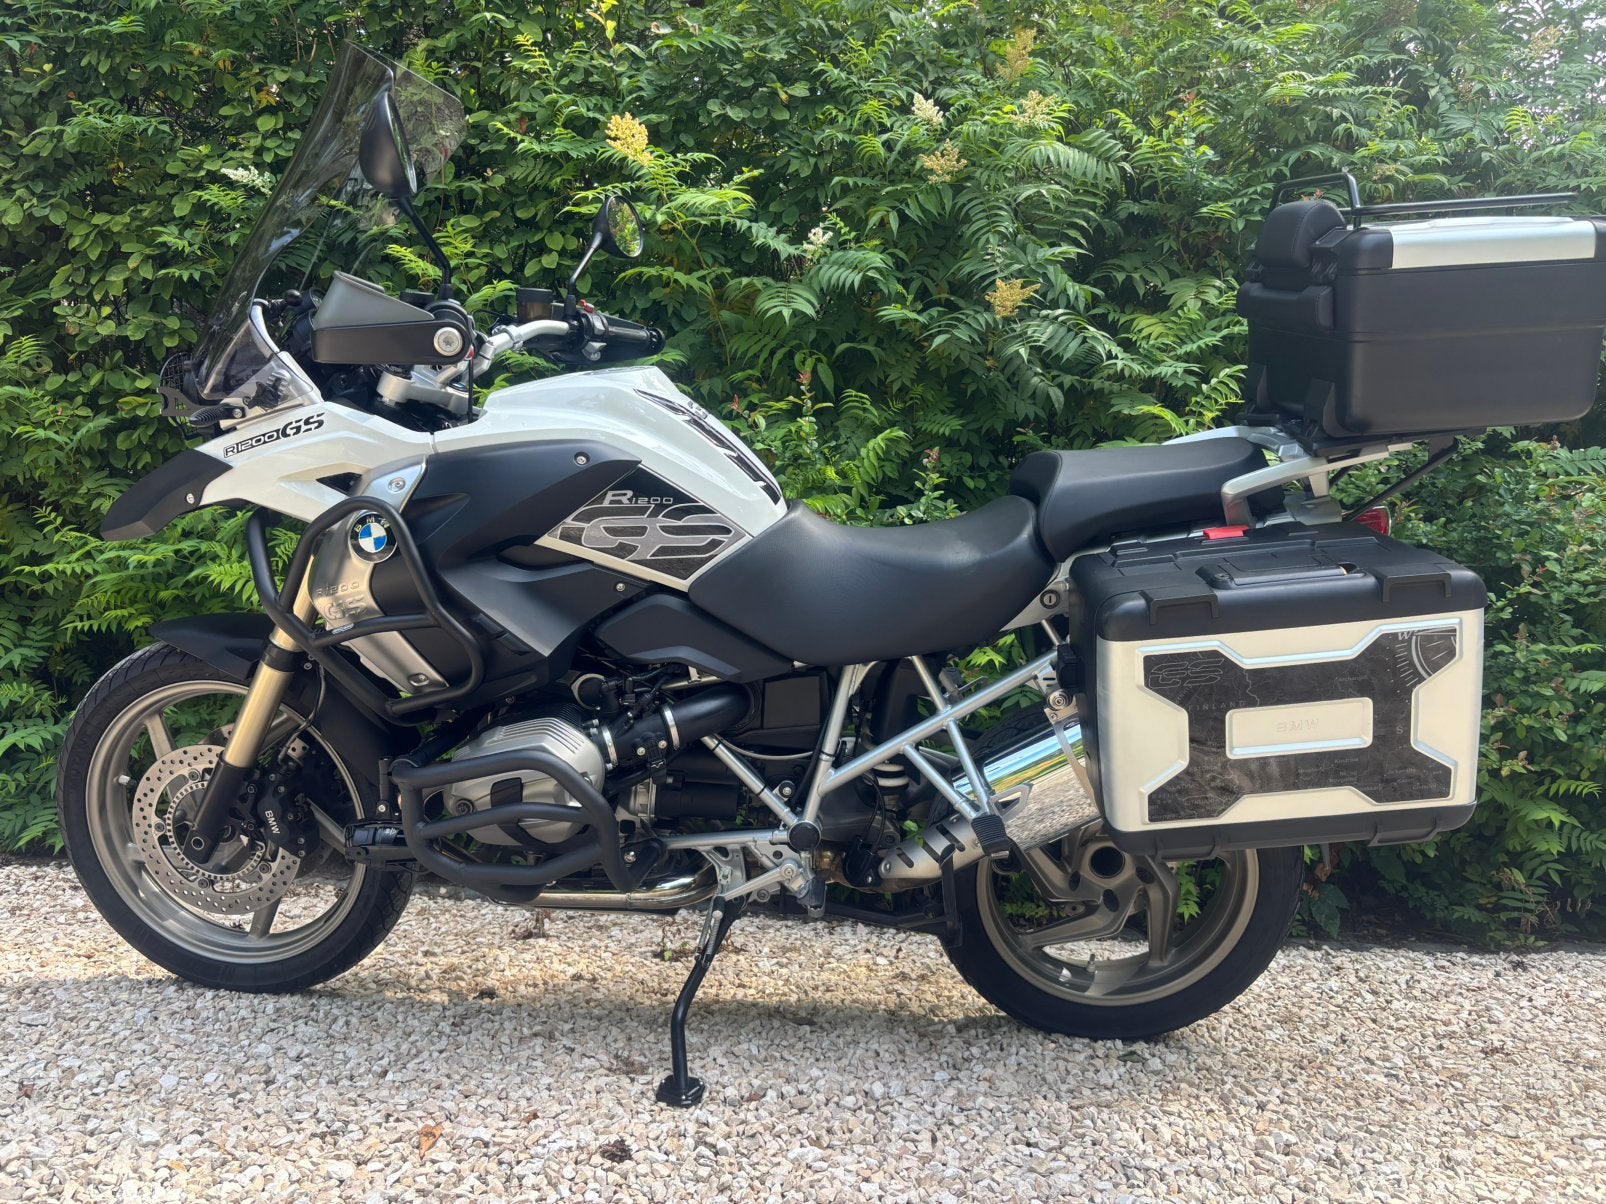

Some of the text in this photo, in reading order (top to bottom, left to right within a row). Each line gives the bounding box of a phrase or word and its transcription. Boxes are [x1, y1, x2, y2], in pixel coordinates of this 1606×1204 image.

[602, 489, 674, 505] R1200
[1149, 658, 1226, 690] GS
[264, 809, 282, 835] BMW
